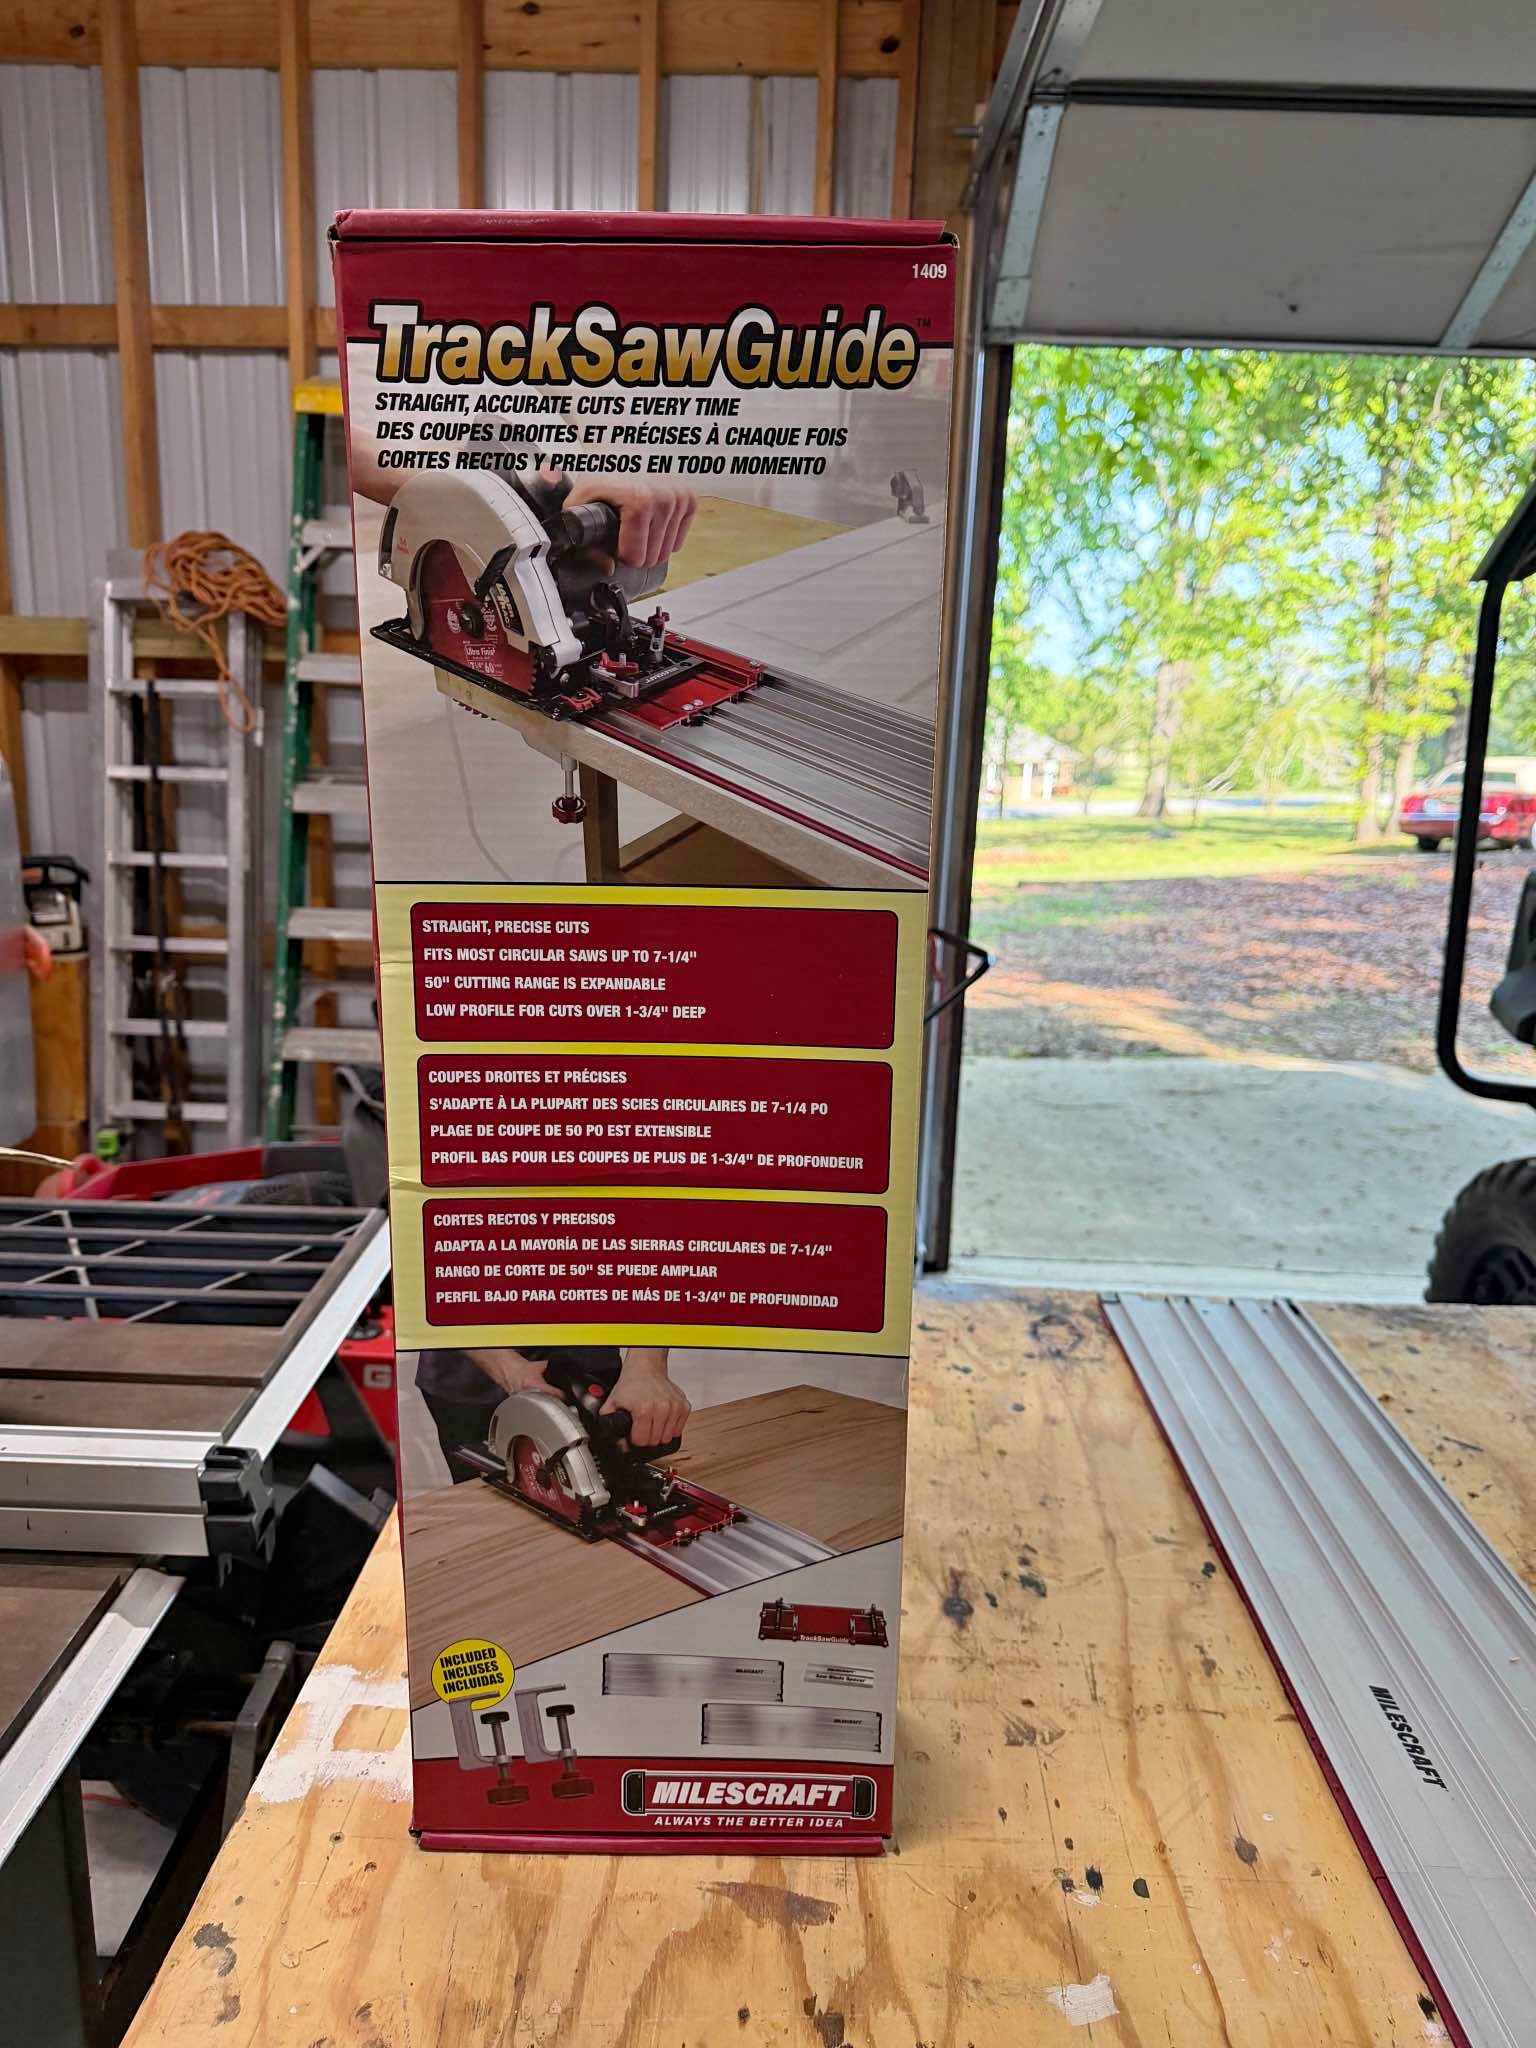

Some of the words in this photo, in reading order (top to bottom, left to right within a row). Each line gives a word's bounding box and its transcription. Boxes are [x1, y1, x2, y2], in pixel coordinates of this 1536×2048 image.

[912, 263, 948, 279] 1409
[370, 301, 920, 389] TrackSawGuide
[375, 392, 470, 417] STRAIGHT,
[473, 394, 573, 414] ACCURATE
[576, 396, 626, 415] CUTS
[630, 396, 692, 416] EVERY
[695, 397, 741, 417] TIME
[376, 421, 415, 440] DES
[419, 422, 494, 442] COUPES
[498, 423, 579, 443] DROITES
[583, 425, 608, 444] ET
[610, 422, 702, 446] PRÉCISES
[705, 423, 719, 445] À
[725, 426, 802, 448] CHAQUE
[804, 427, 849, 447] FOIS
[377, 449, 451, 470] CORTES
[455, 451, 529, 475] RECTOS
[533, 452, 547, 471] Y
[549, 453, 642, 473] PRECISOS
[646, 455, 673, 474] EN
[677, 455, 726, 475] TODO
[729, 456, 827, 476] MOMENTO
[422, 919, 491, 936] STRAIGHT,
[494, 920, 552, 934] PRECISE
[555, 920, 590, 934] CUTS
[423, 947, 453, 961] FITS
[456, 948, 496, 961] MOST
[499, 948, 565, 962] CIRCULAR
[569, 949, 608, 962] SAWS
[611, 949, 630, 963] UP
[632, 949, 650, 963] TO
[653, 950, 697, 964] 7-1/4"
[424, 975, 450, 989] 50"
[454, 975, 511, 989] CUTTING
[514, 976, 560, 990] RANGE
[563, 976, 577, 990] IS
[580, 977, 666, 991] EXPANDABLE
[426, 1003, 456, 1017] LOW
[459, 1003, 515, 1017] PROFILE
[518, 1004, 545, 1017] FOR
[548, 1004, 583, 1017] CUTS
[586, 1004, 621, 1018] OVER
[625, 1005, 668, 1018] 1-3/4"
[672, 1005, 706, 1019] DEEP
[428, 1070, 481, 1084] COUPES
[485, 1070, 541, 1083] DROITES
[544, 1070, 561, 1083] ET
[563, 1068, 627, 1084] PRÉCISES
[429, 1097, 494, 1111] S'ADAPTE
[497, 1094, 507, 1110] À
[510, 1097, 528, 1110] LA
[530, 1097, 589, 1110] PLUPART
[592, 1097, 618, 1110] DES
[621, 1097, 659, 1111] SCIES
[662, 1098, 747, 1113] CIRCULAIRES
[750, 1100, 768, 1113] DE
[771, 1101, 807, 1114] 7-1/4
[810, 1102, 828, 1115] PO
[430, 1124, 473, 1137] PLAGE
[476, 1124, 494, 1137] DE
[497, 1124, 541, 1137] COUPE
[544, 1124, 562, 1137] DE
[565, 1124, 583, 1137] 50
[586, 1124, 604, 1137] PO
[607, 1124, 632, 1137] EST
[634, 1124, 712, 1138] EXTENSIBLE
[431, 1151, 478, 1164] PROFIL
[481, 1150, 508, 1164] BAS
[512, 1150, 547, 1164] POUR
[551, 1150, 575, 1163] LES
[578, 1150, 630, 1164] COUPES
[633, 1151, 650, 1164] DE
[653, 1151, 687, 1164] PLUS
[690, 1152, 707, 1165] DE
[711, 1152, 753, 1166] 1-3/4"
[757, 1153, 774, 1166] DE
[777, 1154, 864, 1170] PROFONDEUR
[433, 1213, 484, 1227] CORTES
[487, 1213, 538, 1226] RECTOS
[540, 1213, 549, 1225] Y
[552, 1213, 616, 1225] PRECISOS
[434, 1239, 485, 1253] ADAPTA
[487, 1239, 498, 1251] A
[500, 1239, 518, 1251] LA
[520, 1237, 579, 1251] MAYORÍA
[581, 1238, 599, 1251] DE
[602, 1238, 627, 1251] LAS
[630, 1238, 685, 1252] SIERRAS
[688, 1239, 766, 1254] CIRCULARES
[770, 1242, 787, 1255] DE
[790, 1243, 832, 1257] 7-1/4"
[435, 1265, 480, 1278] RANGO
[484, 1264, 501, 1277] DE
[504, 1264, 546, 1277] CORTE
[549, 1264, 566, 1276] DE
[569, 1264, 593, 1276] 50"
[597, 1263, 614, 1276] SE
[617, 1264, 658, 1277] PUEDE
[660, 1264, 718, 1278] AMPLIAR
[436, 1290, 481, 1303] PERFIL
[484, 1289, 519, 1302] BAJO
[521, 1289, 557, 1302] PARA
[559, 1289, 608, 1301] CORTES
[611, 1289, 629, 1301] DE
[632, 1289, 661, 1302] MÁS
[664, 1289, 681, 1302] DE
[684, 1290, 726, 1303] 1-3/4"
[729, 1291, 747, 1304] DE
[749, 1292, 839, 1308] PROFUNDIDAD
[439, 1647, 497, 1669] INCLUDED
[442, 1660, 500, 1681] INCLUSES
[442, 1672, 505, 1694] INCLUIDAS
[1368, 1684, 1448, 1791] MILESCRAFT
[652, 1781, 847, 1807] MILESCRAFT
[654, 1816, 711, 1827] ALWAYS
[717, 1816, 744, 1827] THE
[750, 1817, 804, 1828] BETTER
[809, 1818, 844, 1828] IDEA
